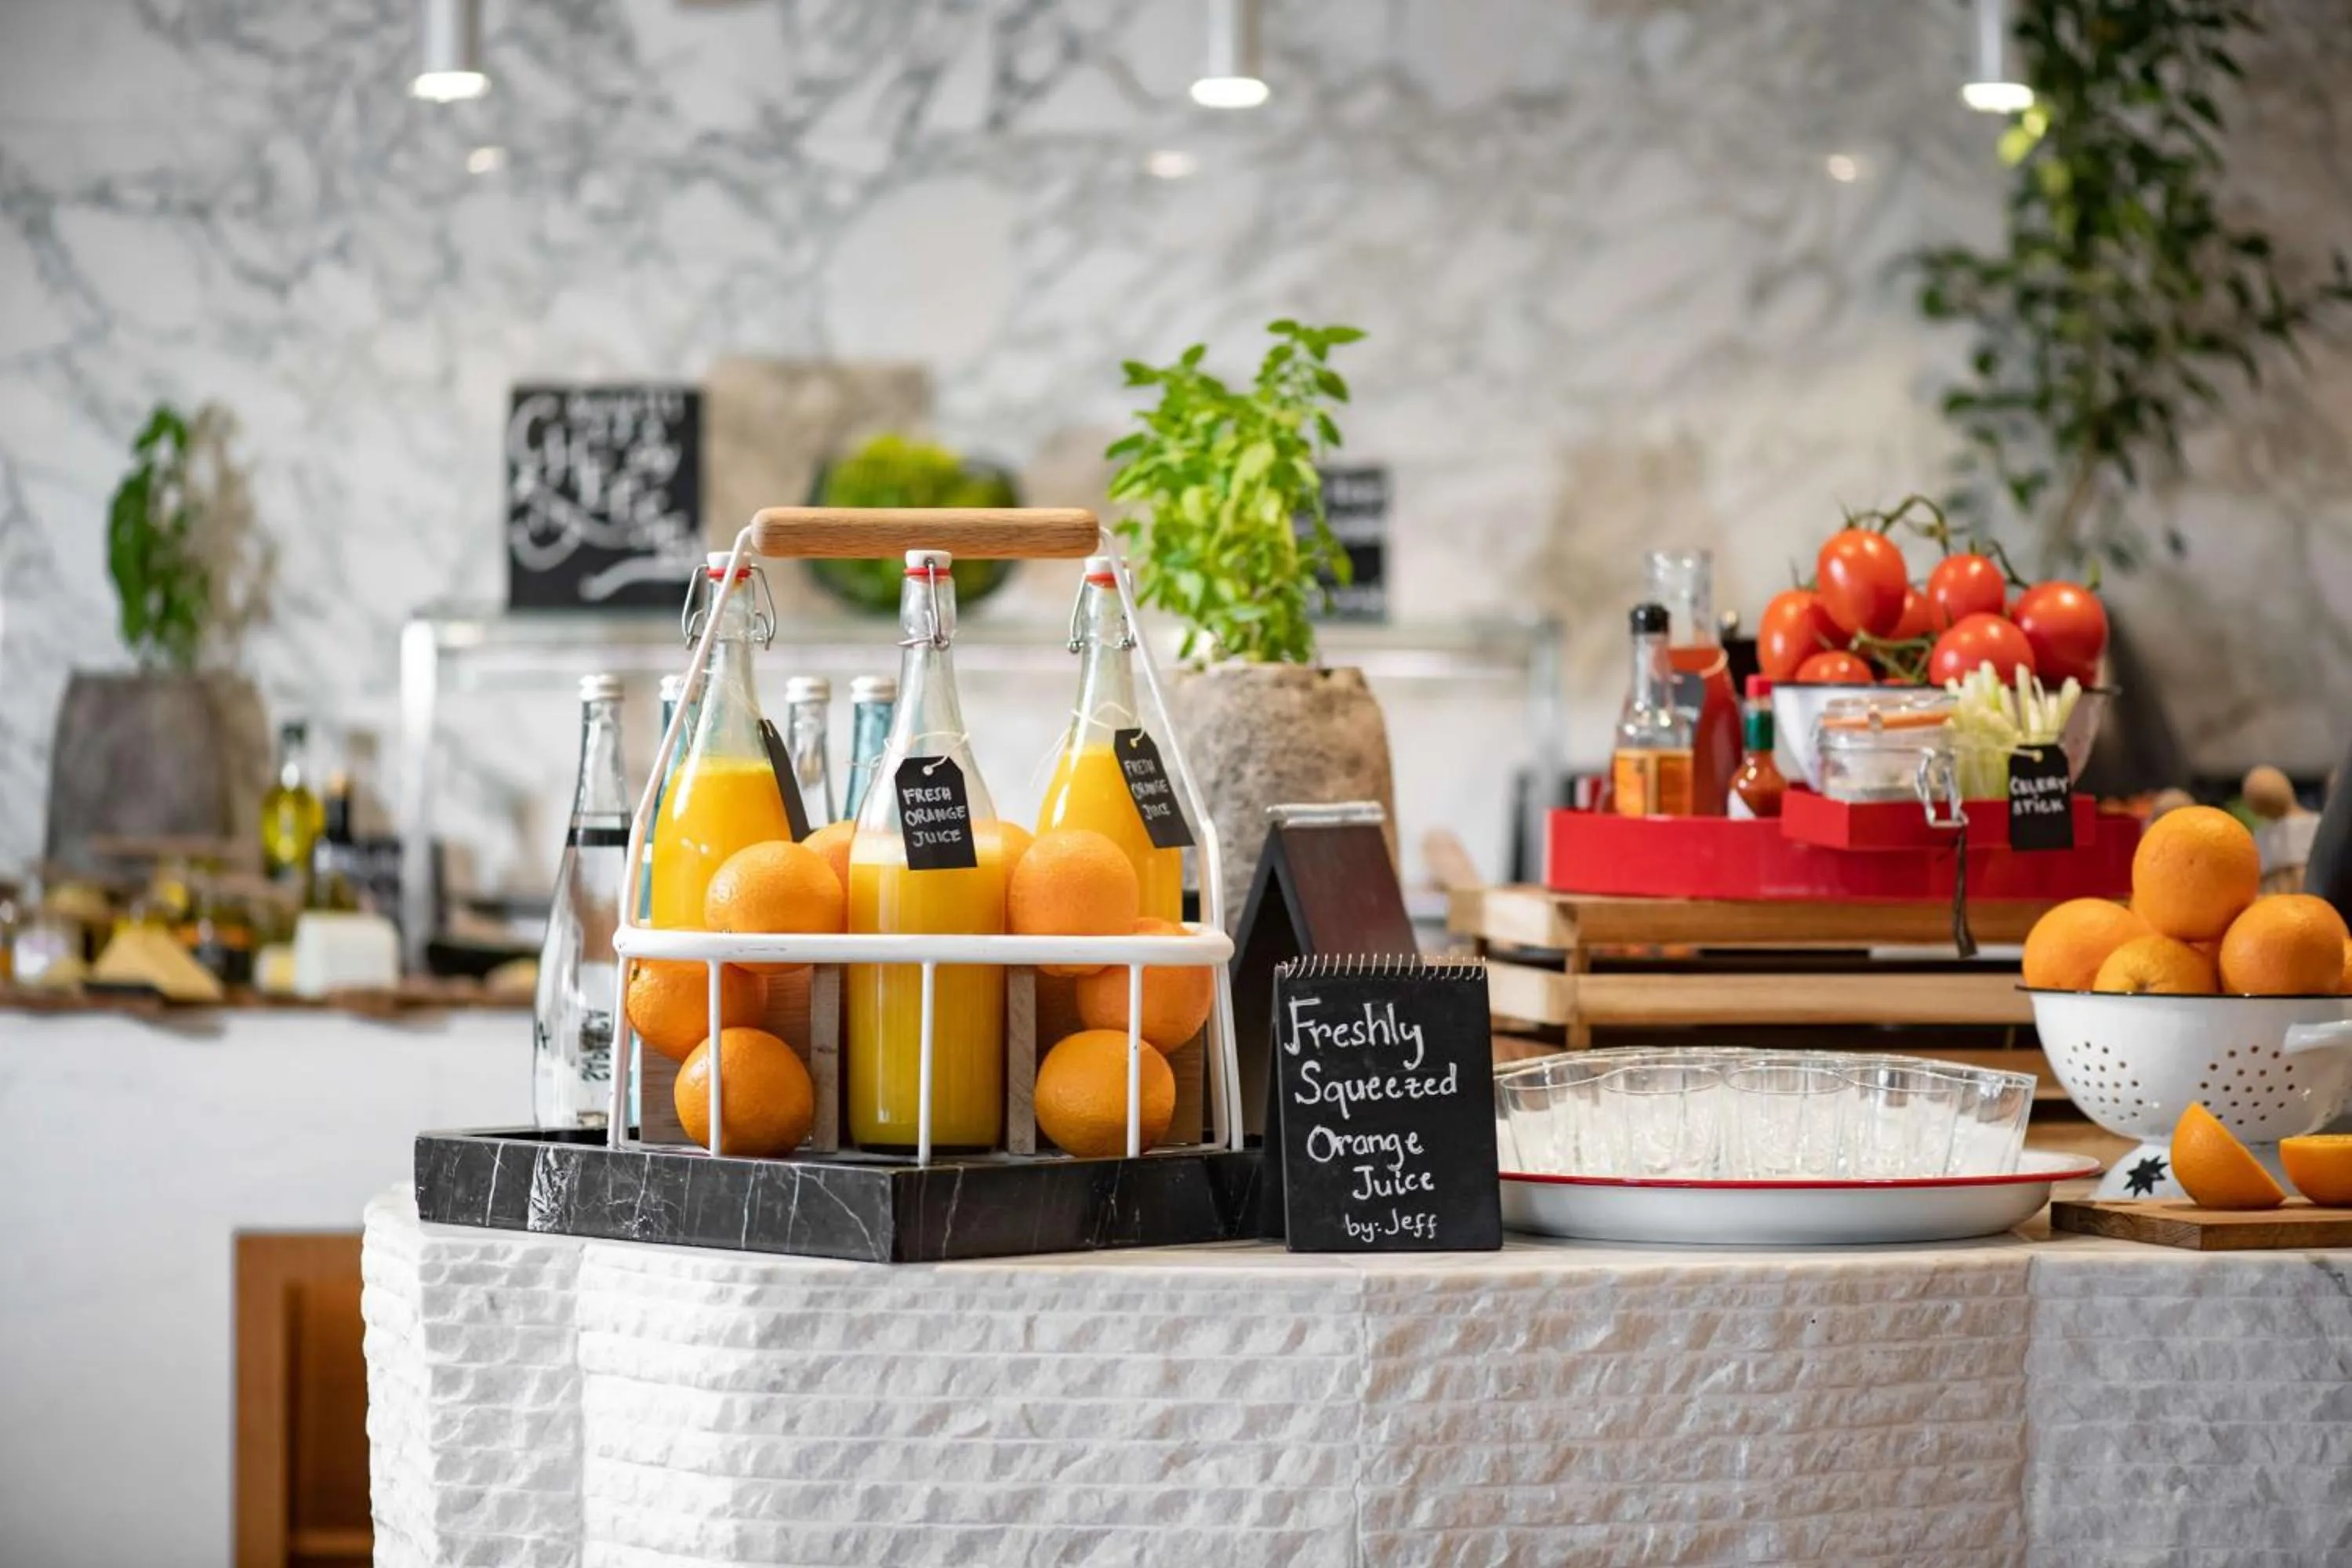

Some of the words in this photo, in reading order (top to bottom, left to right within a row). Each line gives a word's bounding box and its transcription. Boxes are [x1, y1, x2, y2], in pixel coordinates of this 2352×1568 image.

[902, 786, 952, 805] FRESH
[905, 805, 966, 827] ORANGE
[912, 829, 962, 848] JUICE
[1283, 995, 1425, 1069] Freshly
[1295, 1060, 1457, 1120] Squeezed
[1306, 1124, 1425, 1170] Orange
[1352, 1165, 1435, 1200] Juice
